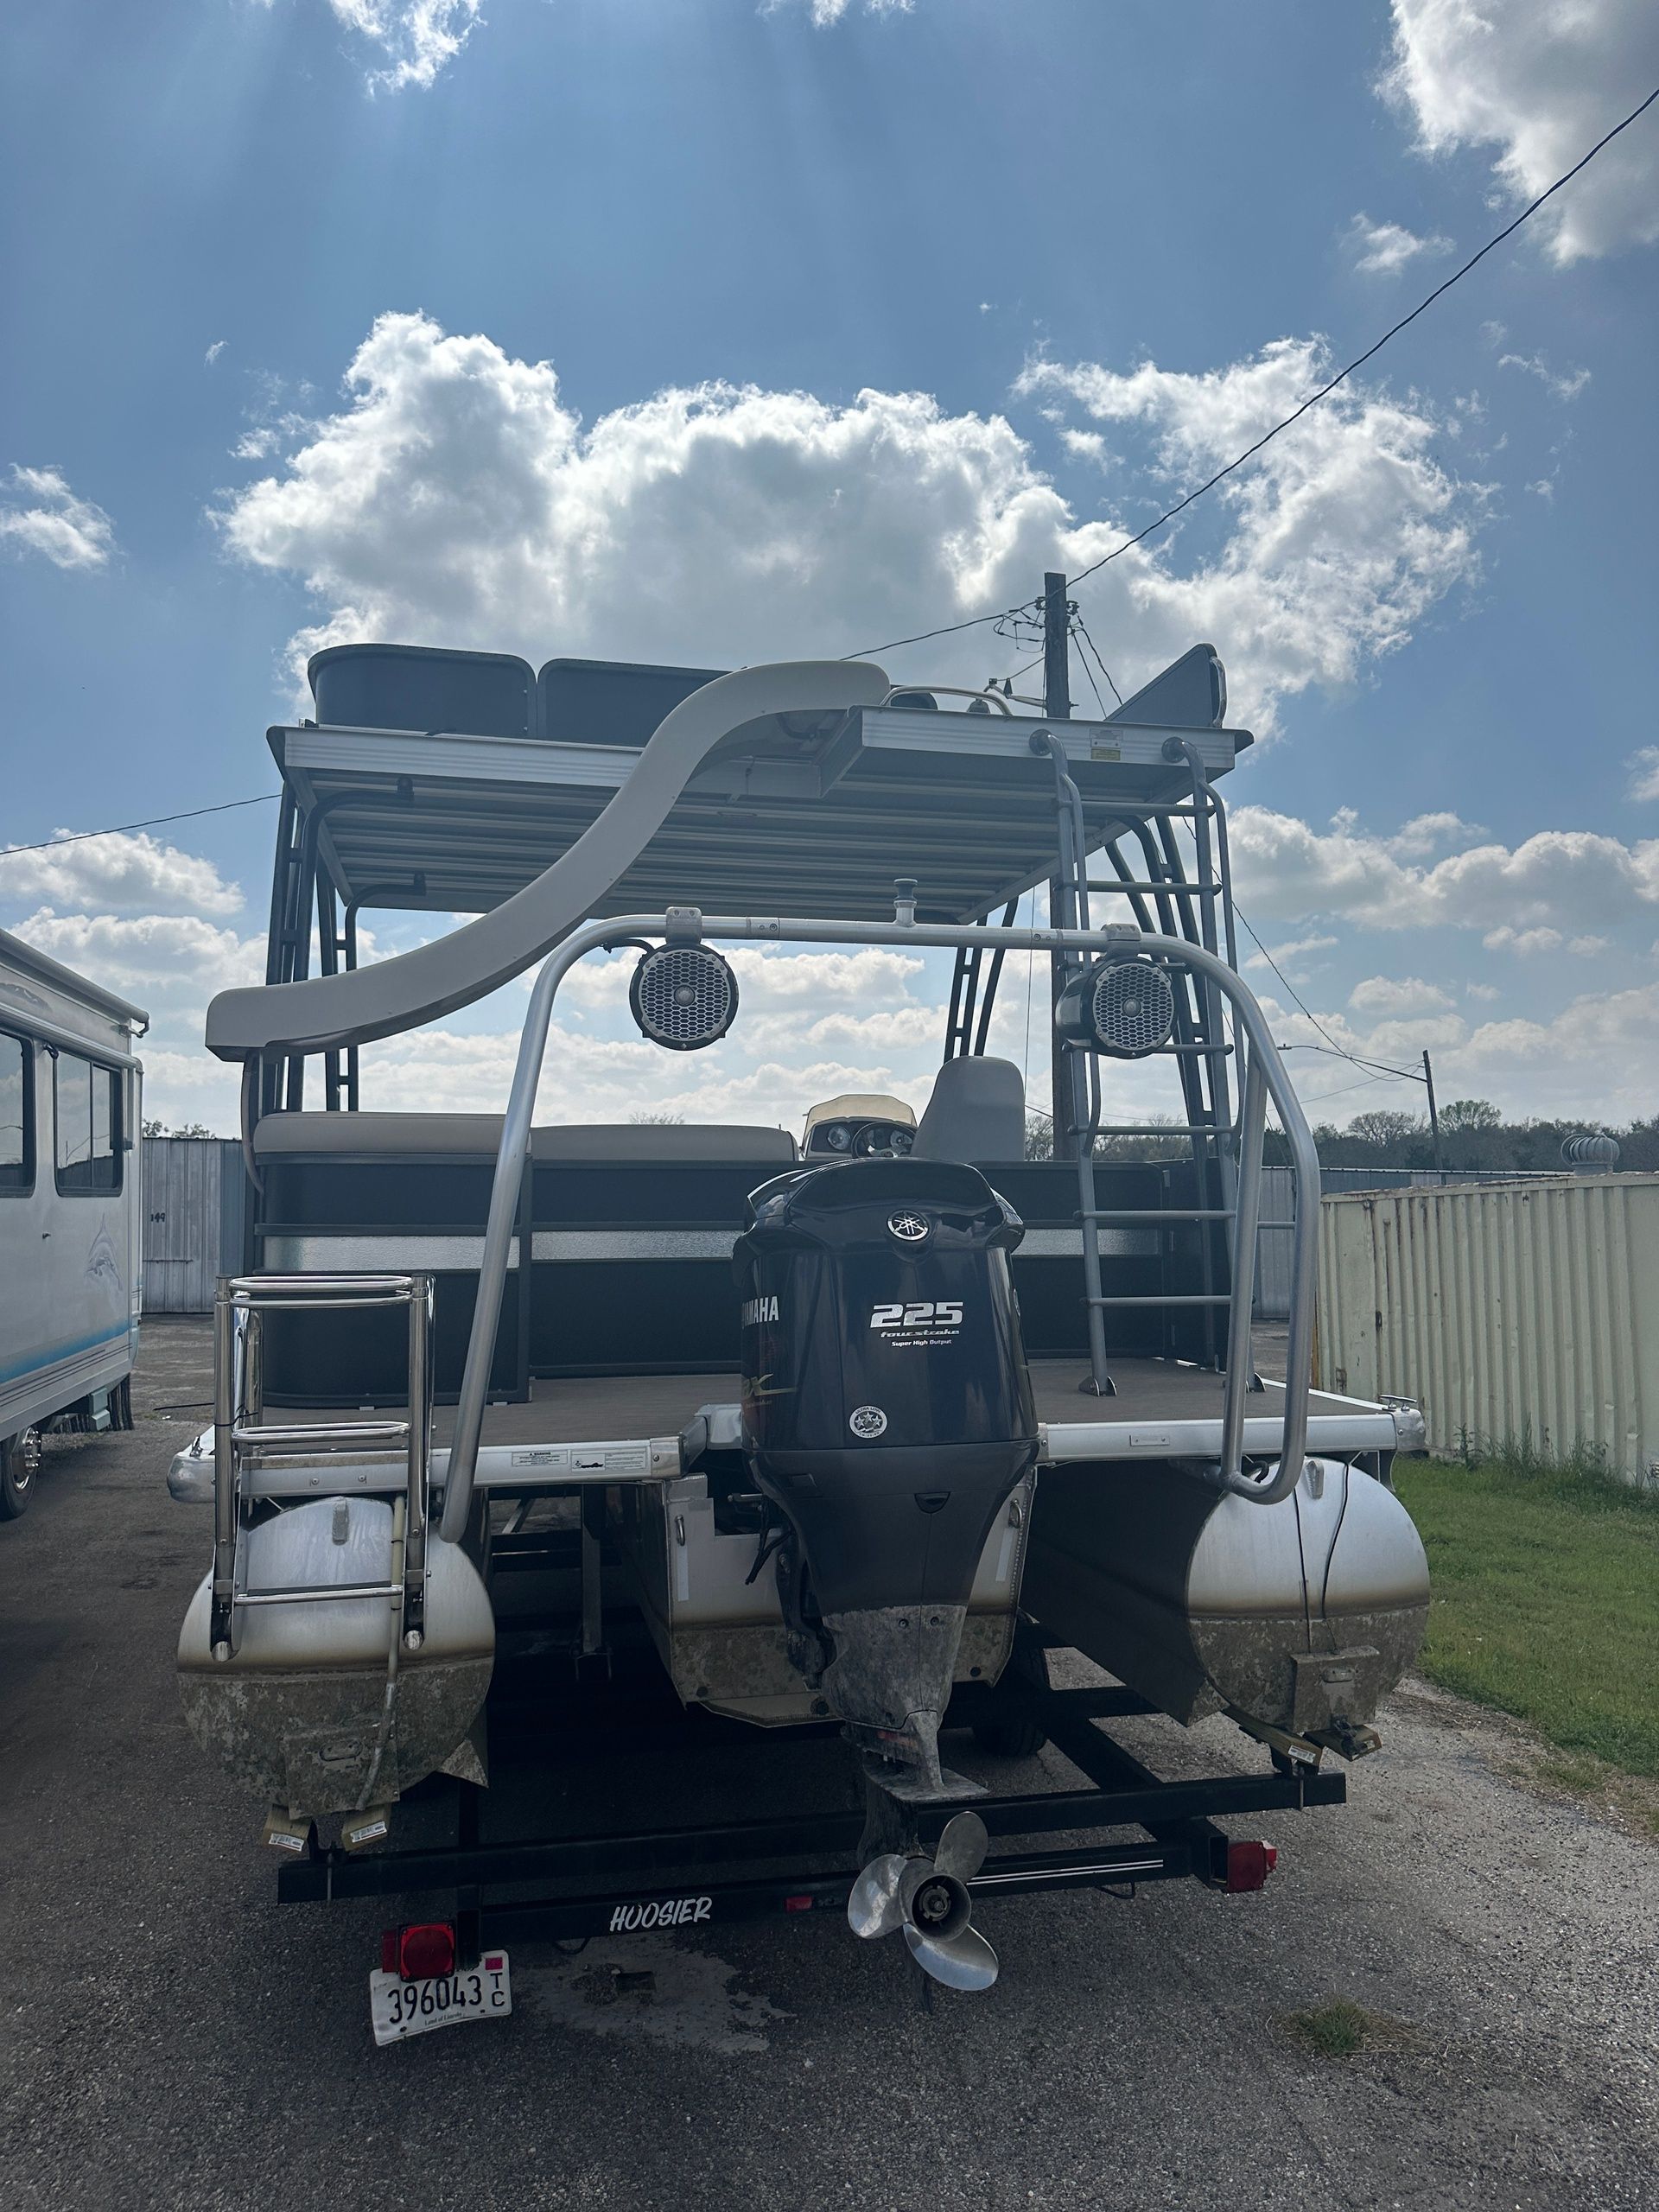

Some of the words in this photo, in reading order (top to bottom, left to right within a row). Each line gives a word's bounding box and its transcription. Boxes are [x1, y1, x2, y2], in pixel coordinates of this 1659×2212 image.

[150, 1212, 166, 1224] 149
[870, 1301, 963, 1328] 225
[609, 1897, 713, 1931] HOOSIER
[387, 1975, 482, 2024] 396043
